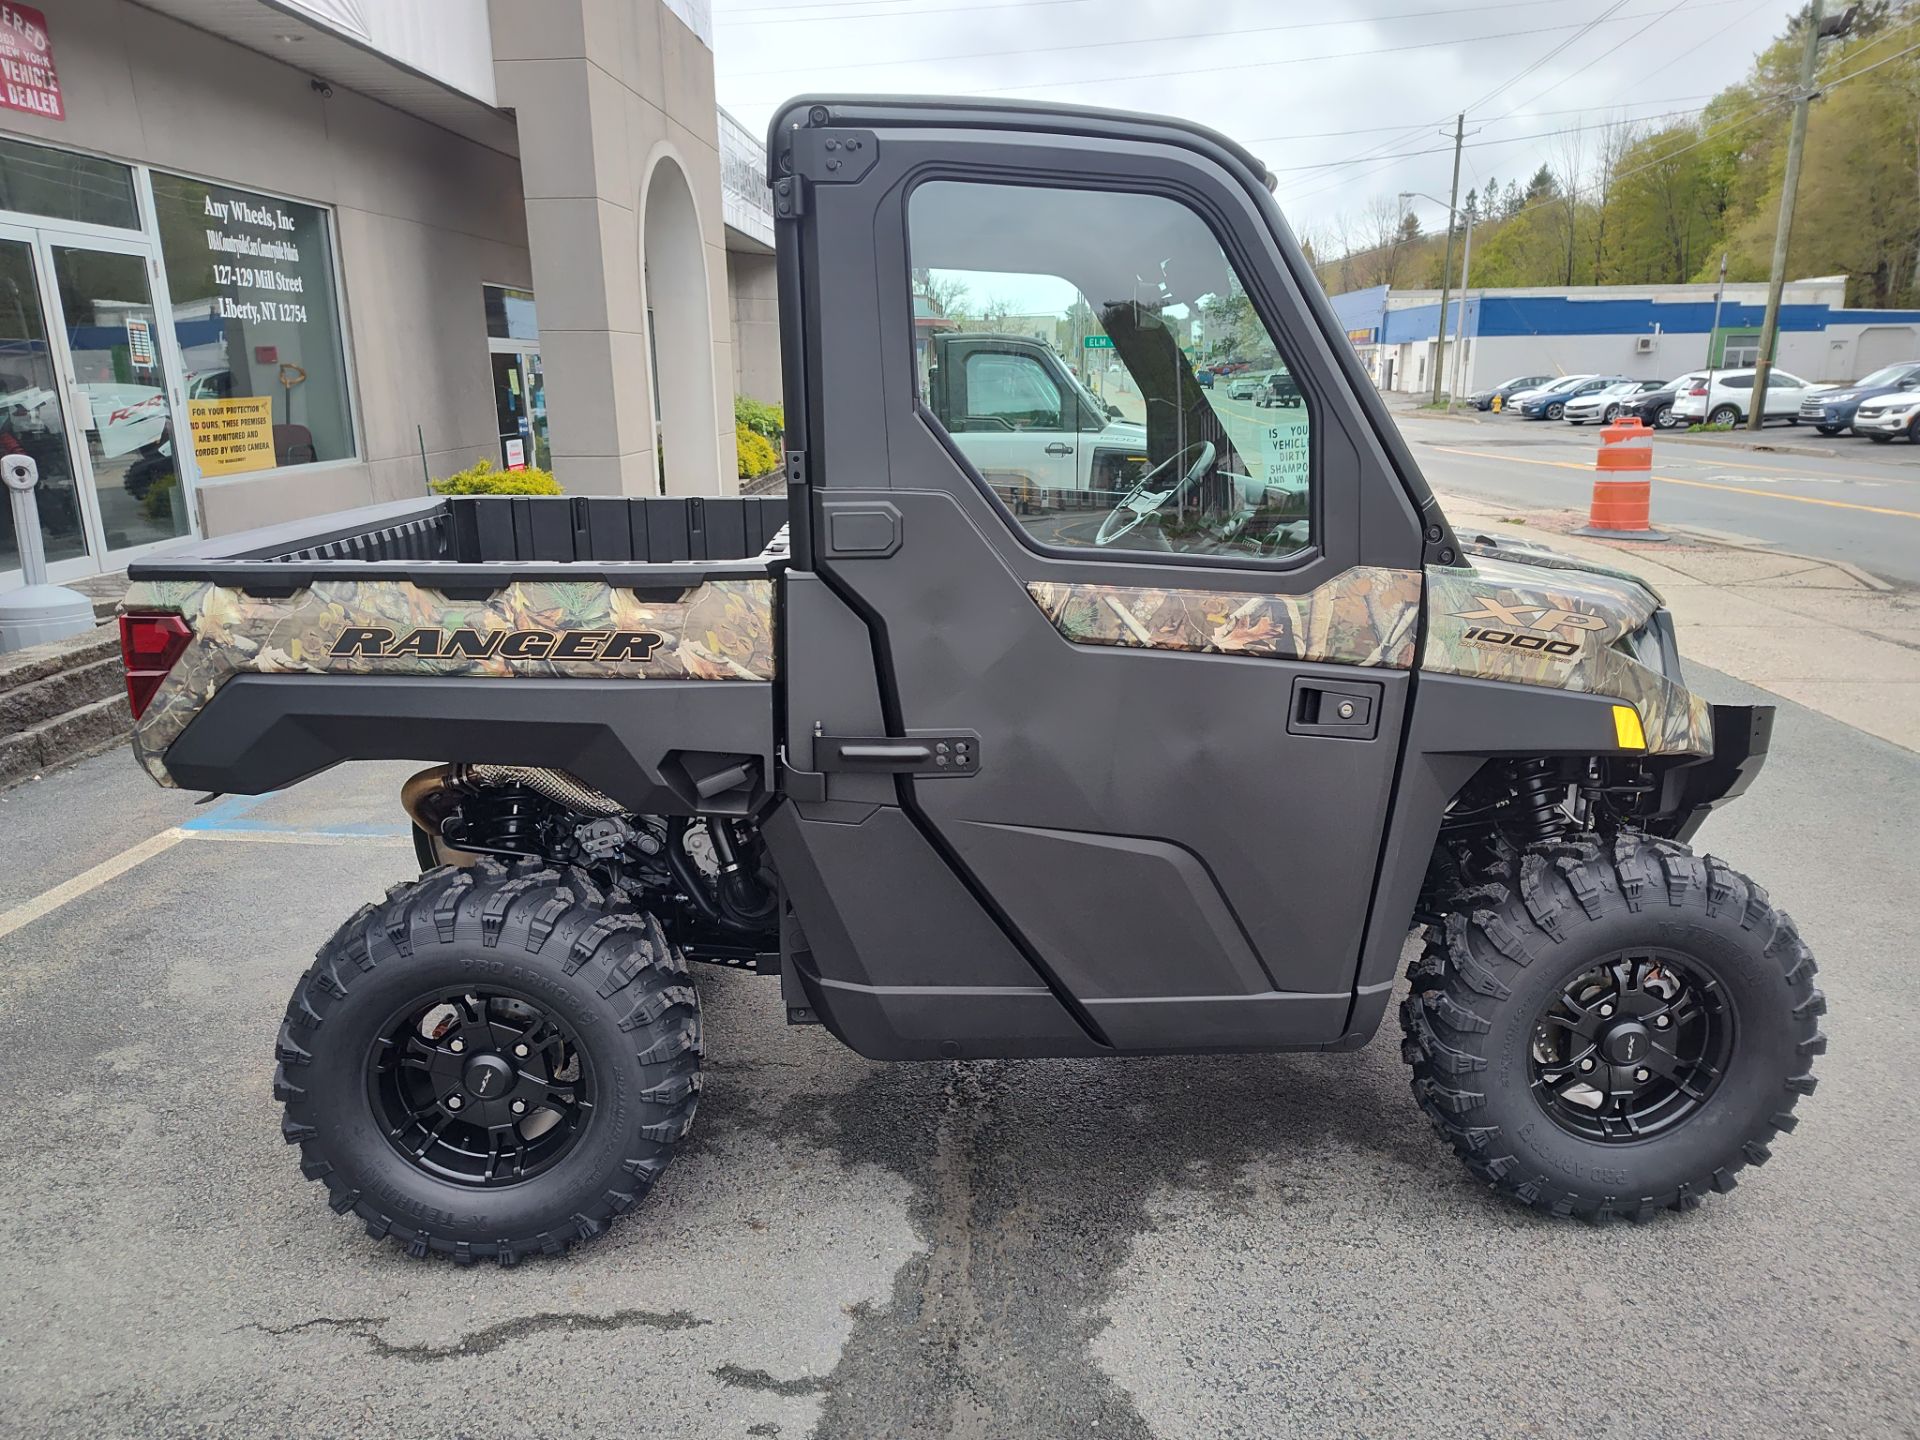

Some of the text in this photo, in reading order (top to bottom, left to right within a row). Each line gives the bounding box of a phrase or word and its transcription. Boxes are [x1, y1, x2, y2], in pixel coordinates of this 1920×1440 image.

[23, 49, 50, 67] YORK
[1, 58, 58, 92] VEHICLE
[7, 83, 60, 115] DEALER
[204, 195, 295, 231] Any Wheels, Inc
[213, 265, 304, 293] 127-129 Mill Street
[218, 298, 307, 325] Liberty, NY 12754
[1089, 338, 1107, 347] ELM
[192, 405, 260, 417] FOR YOUR PROTECTION
[222, 419, 240, 428] THESE
[240, 417, 267, 427] PREMISES
[198, 430, 259, 443] ARE MONITORED AND
[1269, 428, 1278, 439] IS
[220, 446, 229, 455] BY
[230, 444, 247, 454] VIDEO
[247, 442, 270, 451] CAMERA
[1280, 450, 1307, 462] DIRTY
[1268, 475, 1285, 485] AND
[1445, 596, 1609, 632] XP
[328, 625, 665, 662] RANGER
[1464, 626, 1581, 656] 1000
